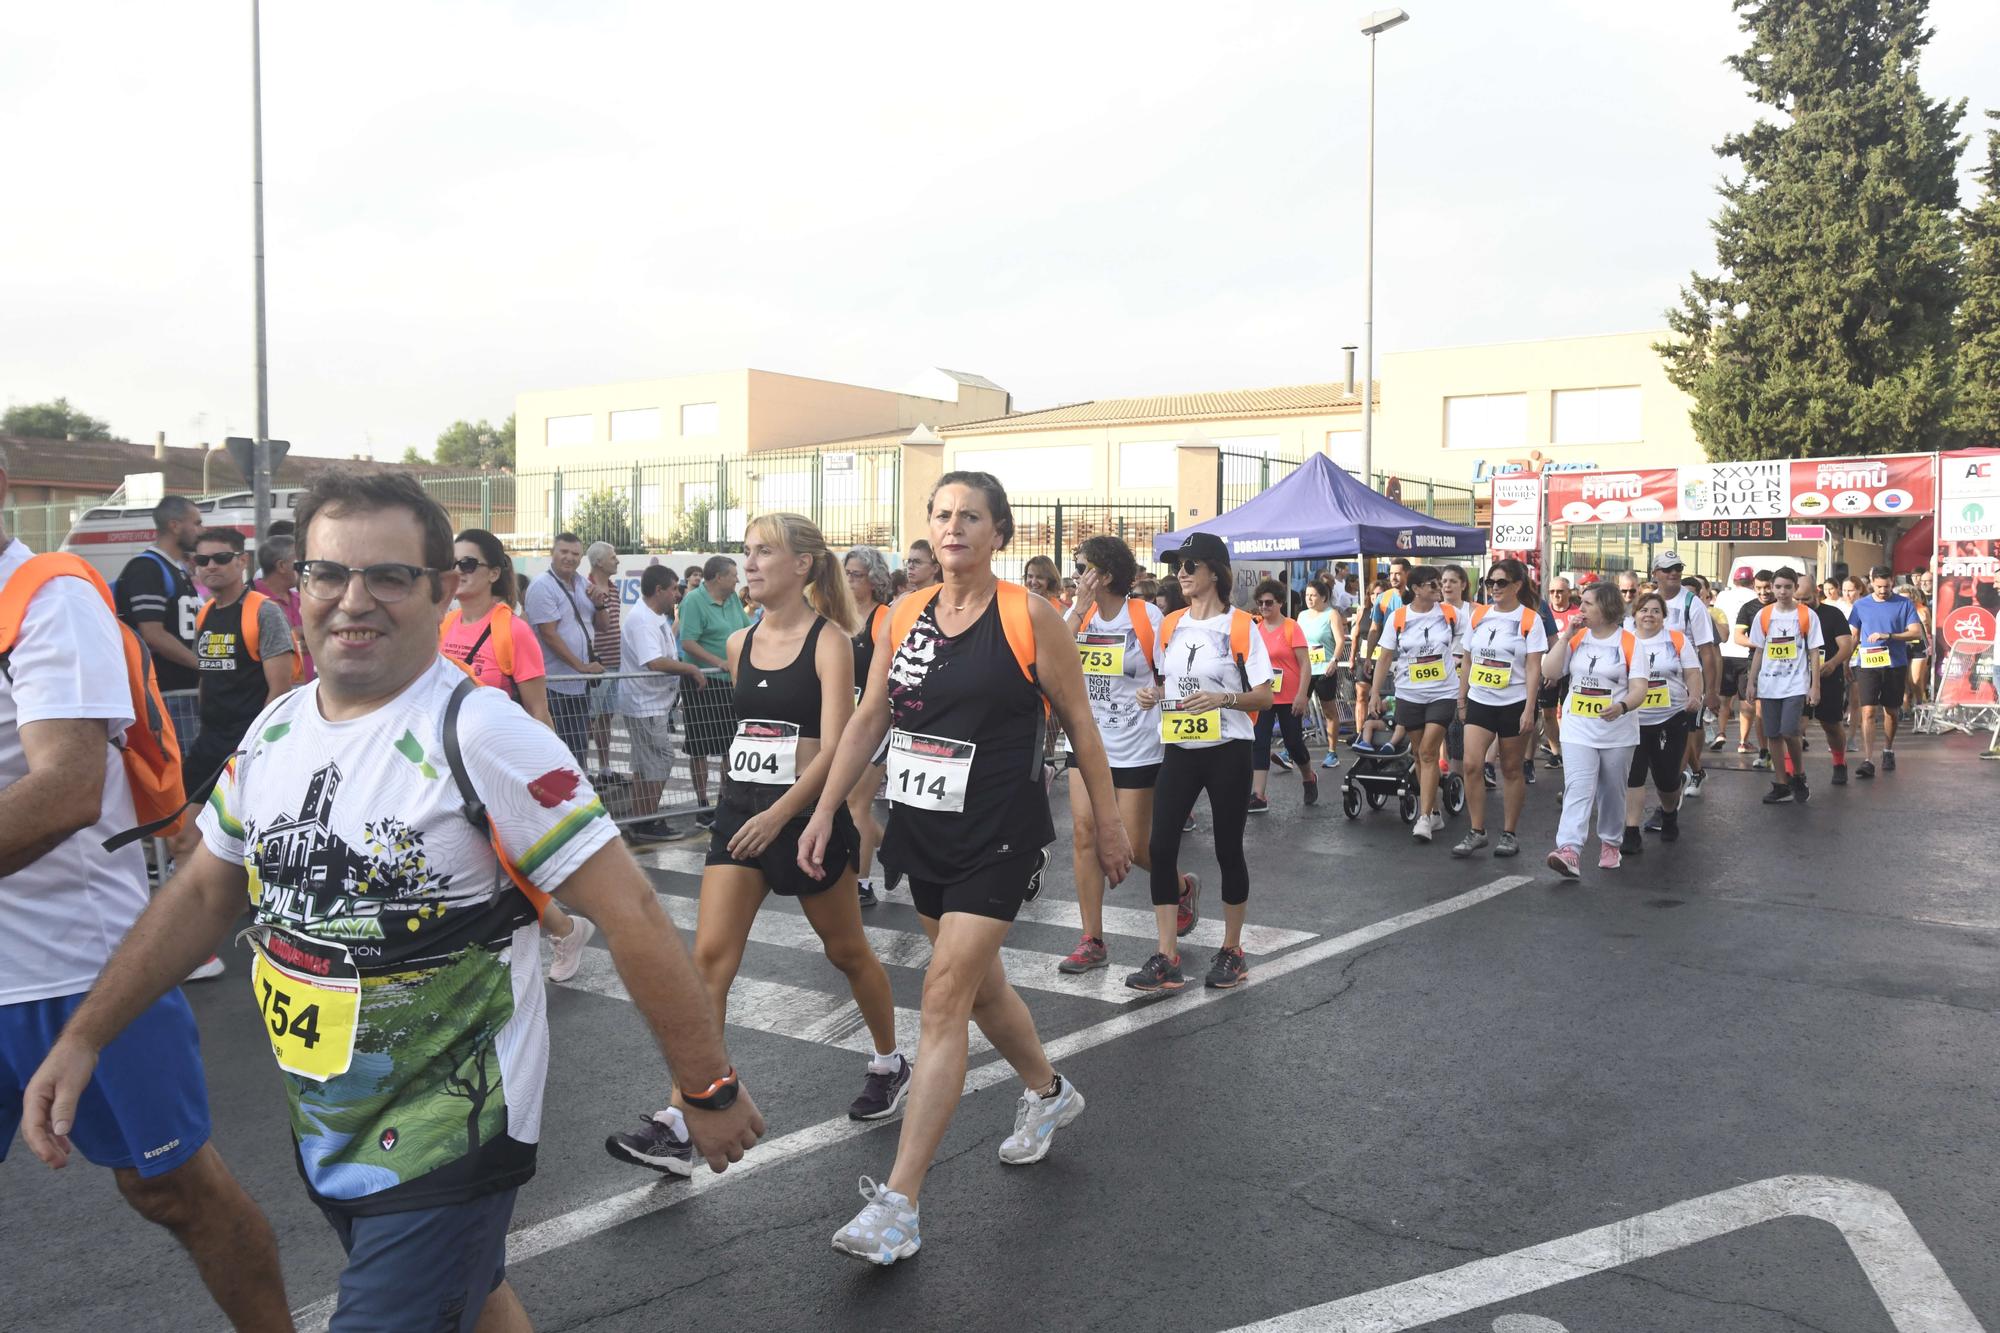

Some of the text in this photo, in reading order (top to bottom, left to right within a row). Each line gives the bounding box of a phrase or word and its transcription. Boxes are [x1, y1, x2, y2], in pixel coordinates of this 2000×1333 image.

[1713, 464, 1781, 479] XXVIII
[1965, 463, 1991, 479] AC
[1713, 477, 1781, 491] NON
[1713, 490, 1781, 504] DUER
[1713, 502, 1781, 516] MAS
[1701, 520, 1773, 537] 0:01:05
[1233, 537, 1300, 554] DORSAL21.COM
[1415, 535, 1456, 548] DORSAL21.COM
[1770, 646, 1790, 655] 701
[199, 660, 222, 669] SPAR
[1080, 650, 1112, 667] 753
[1866, 655, 1885, 664] 808
[1415, 667, 1440, 679] 696
[1477, 671, 1502, 685] 783
[1088, 678, 1111, 687] NON
[1178, 682, 1201, 691] NON
[1088, 685, 1111, 695] DUER
[1089, 692, 1111, 702] MAS
[1576, 700, 1603, 714] 710
[1171, 717, 1209, 735] 738
[733, 750, 779, 774] 004
[898, 768, 947, 800] 114
[262, 978, 321, 1049] 754
[143, 1138, 180, 1160] kipsta
